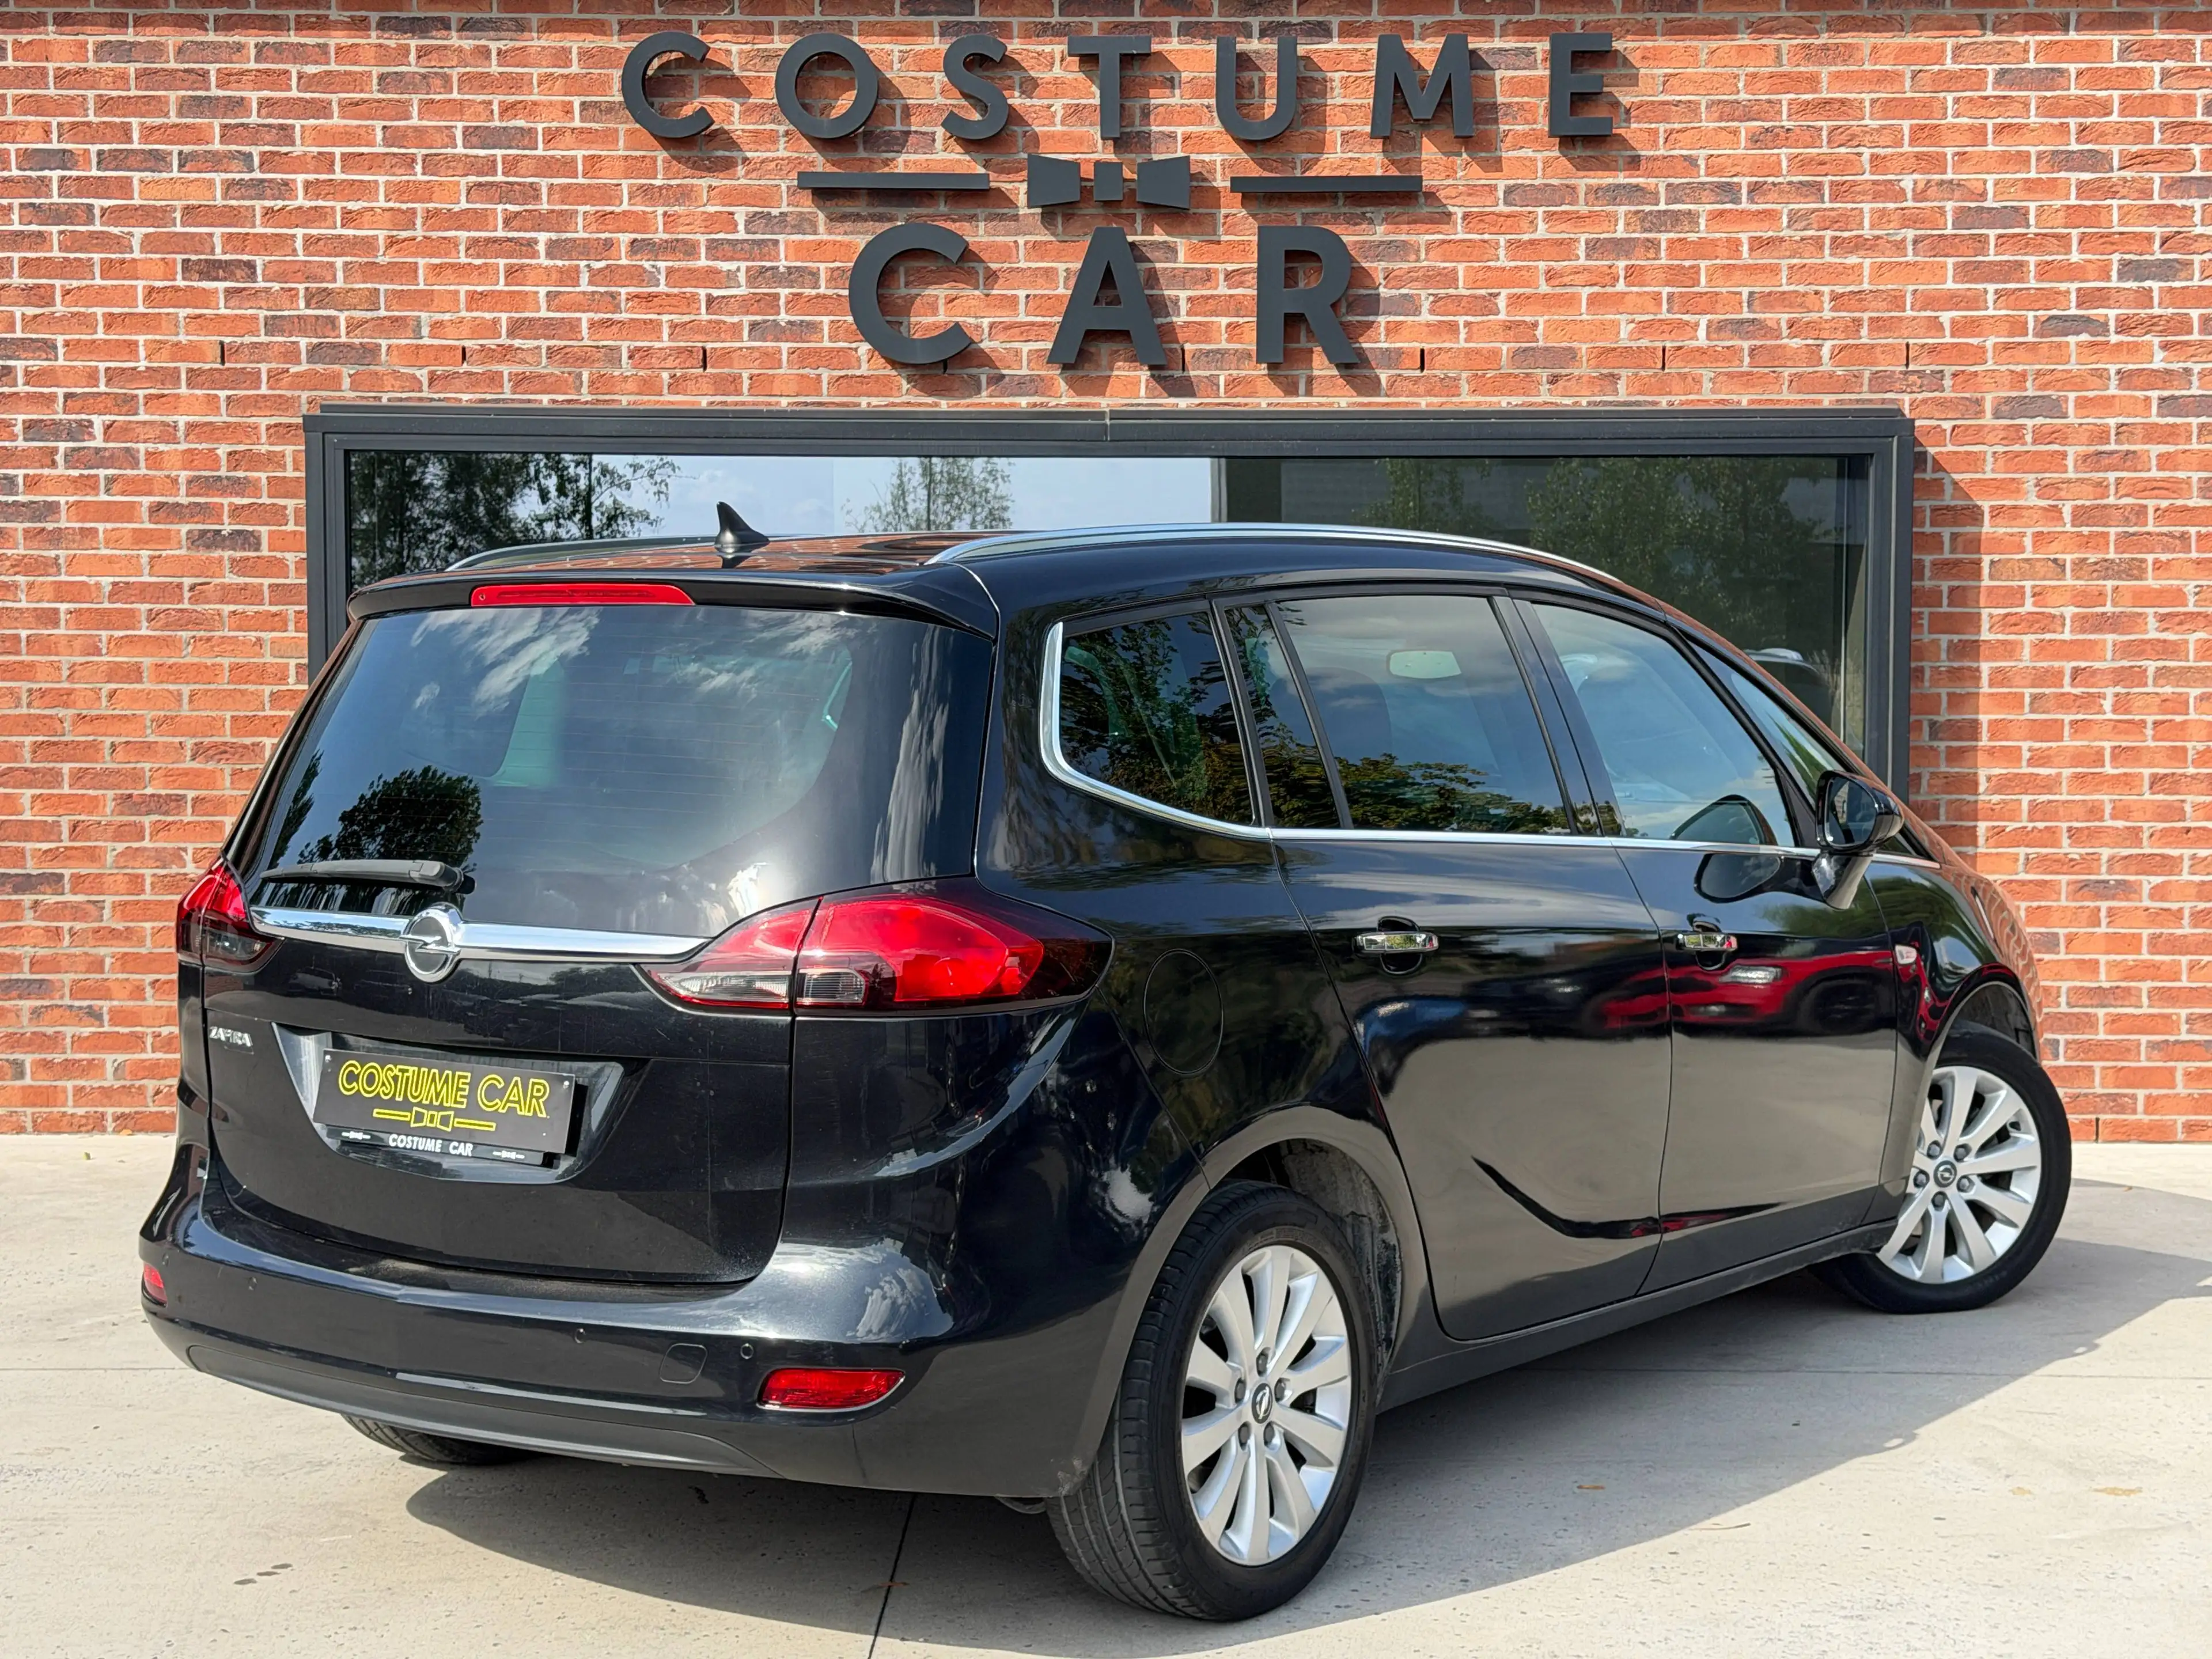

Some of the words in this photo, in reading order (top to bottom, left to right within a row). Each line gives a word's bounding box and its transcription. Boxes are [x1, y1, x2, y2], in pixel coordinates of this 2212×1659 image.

[622, 31, 1613, 141] COSTUME
[848, 222, 1361, 366] CAR
[338, 1059, 471, 1109] COSTUME
[477, 1074, 550, 1118] CAR
[388, 1132, 442, 1153] COSTUME
[449, 1141, 474, 1157] CAR
